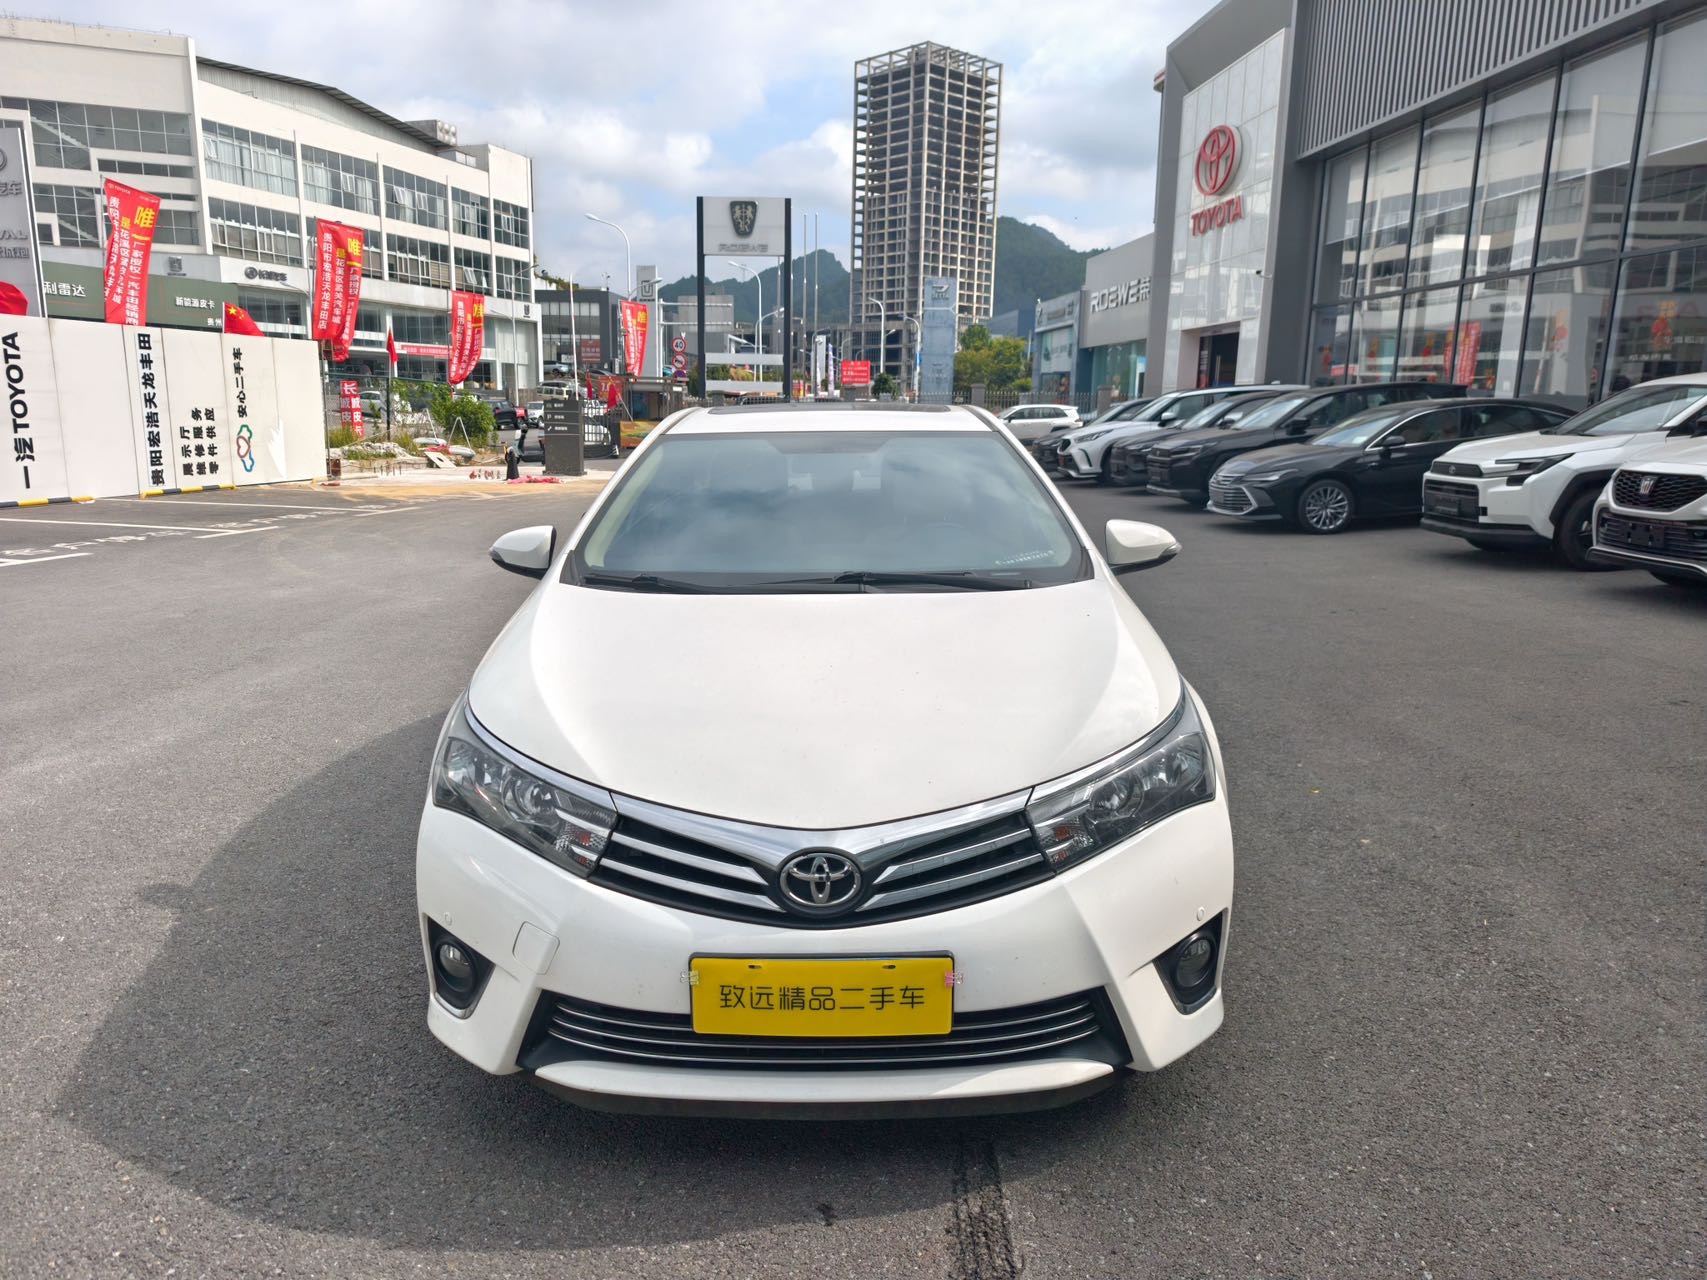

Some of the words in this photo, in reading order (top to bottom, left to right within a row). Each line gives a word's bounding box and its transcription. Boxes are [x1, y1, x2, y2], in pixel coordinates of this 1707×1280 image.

[1191, 196, 1243, 237] TOYOTA
[1090, 280, 1140, 314] ROEWE
[138, 333, 165, 486] 贵阳宏浩天龙丰田
[232, 347, 247, 418] 安心二手车
[180, 426, 194, 476] 展示厅
[192, 407, 207, 476] 维修服务
[205, 407, 219, 474] 零件供应
[719, 984, 925, 1011] 致远精品二手车
